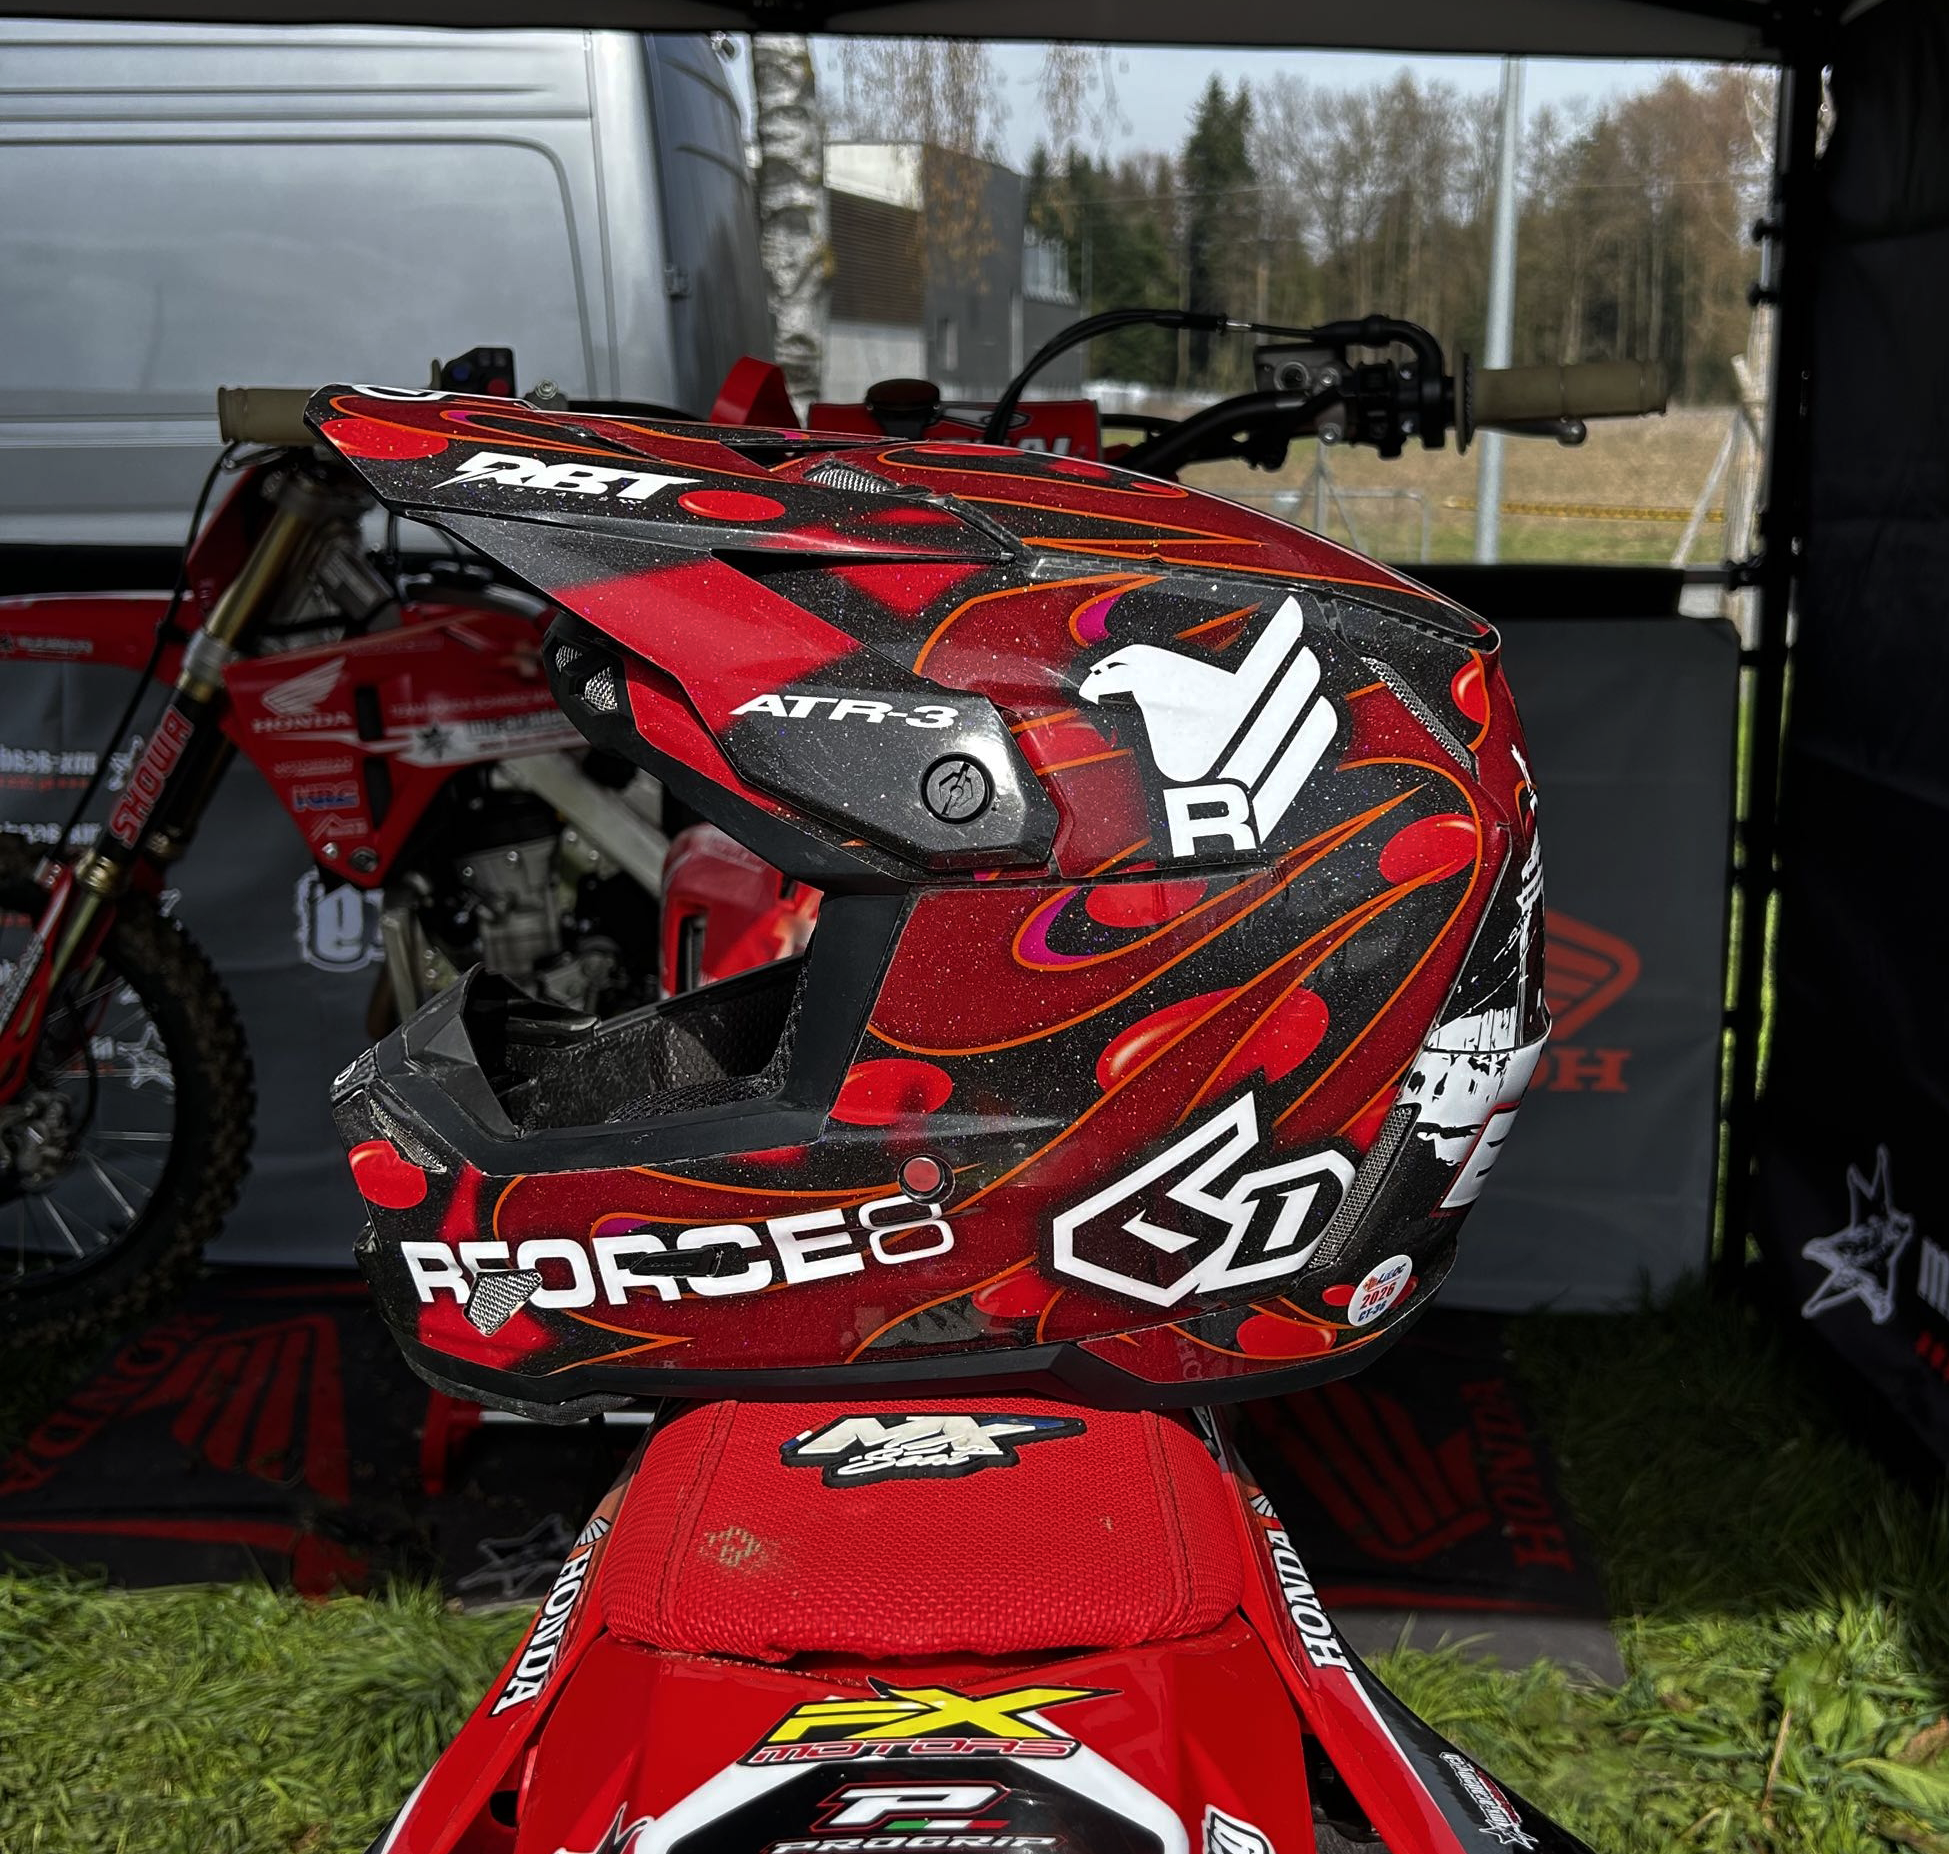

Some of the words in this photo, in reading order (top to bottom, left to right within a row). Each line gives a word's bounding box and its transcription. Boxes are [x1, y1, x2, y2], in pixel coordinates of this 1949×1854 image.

[251, 711, 353, 733] HONDA
[730, 694, 959, 728] ATR-3
[109, 704, 195, 850] SHOWA
[1360, 1282, 1397, 1310] 2026
[797, 1415, 1036, 1456] MX
[1268, 1528, 1353, 1672] HONDA
[489, 1552, 592, 1717] HONDA
[767, 1686, 1096, 1741] FX
[754, 1737, 1071, 1764] MOTORS
[772, 1836, 1056, 1854] PROGRIP
